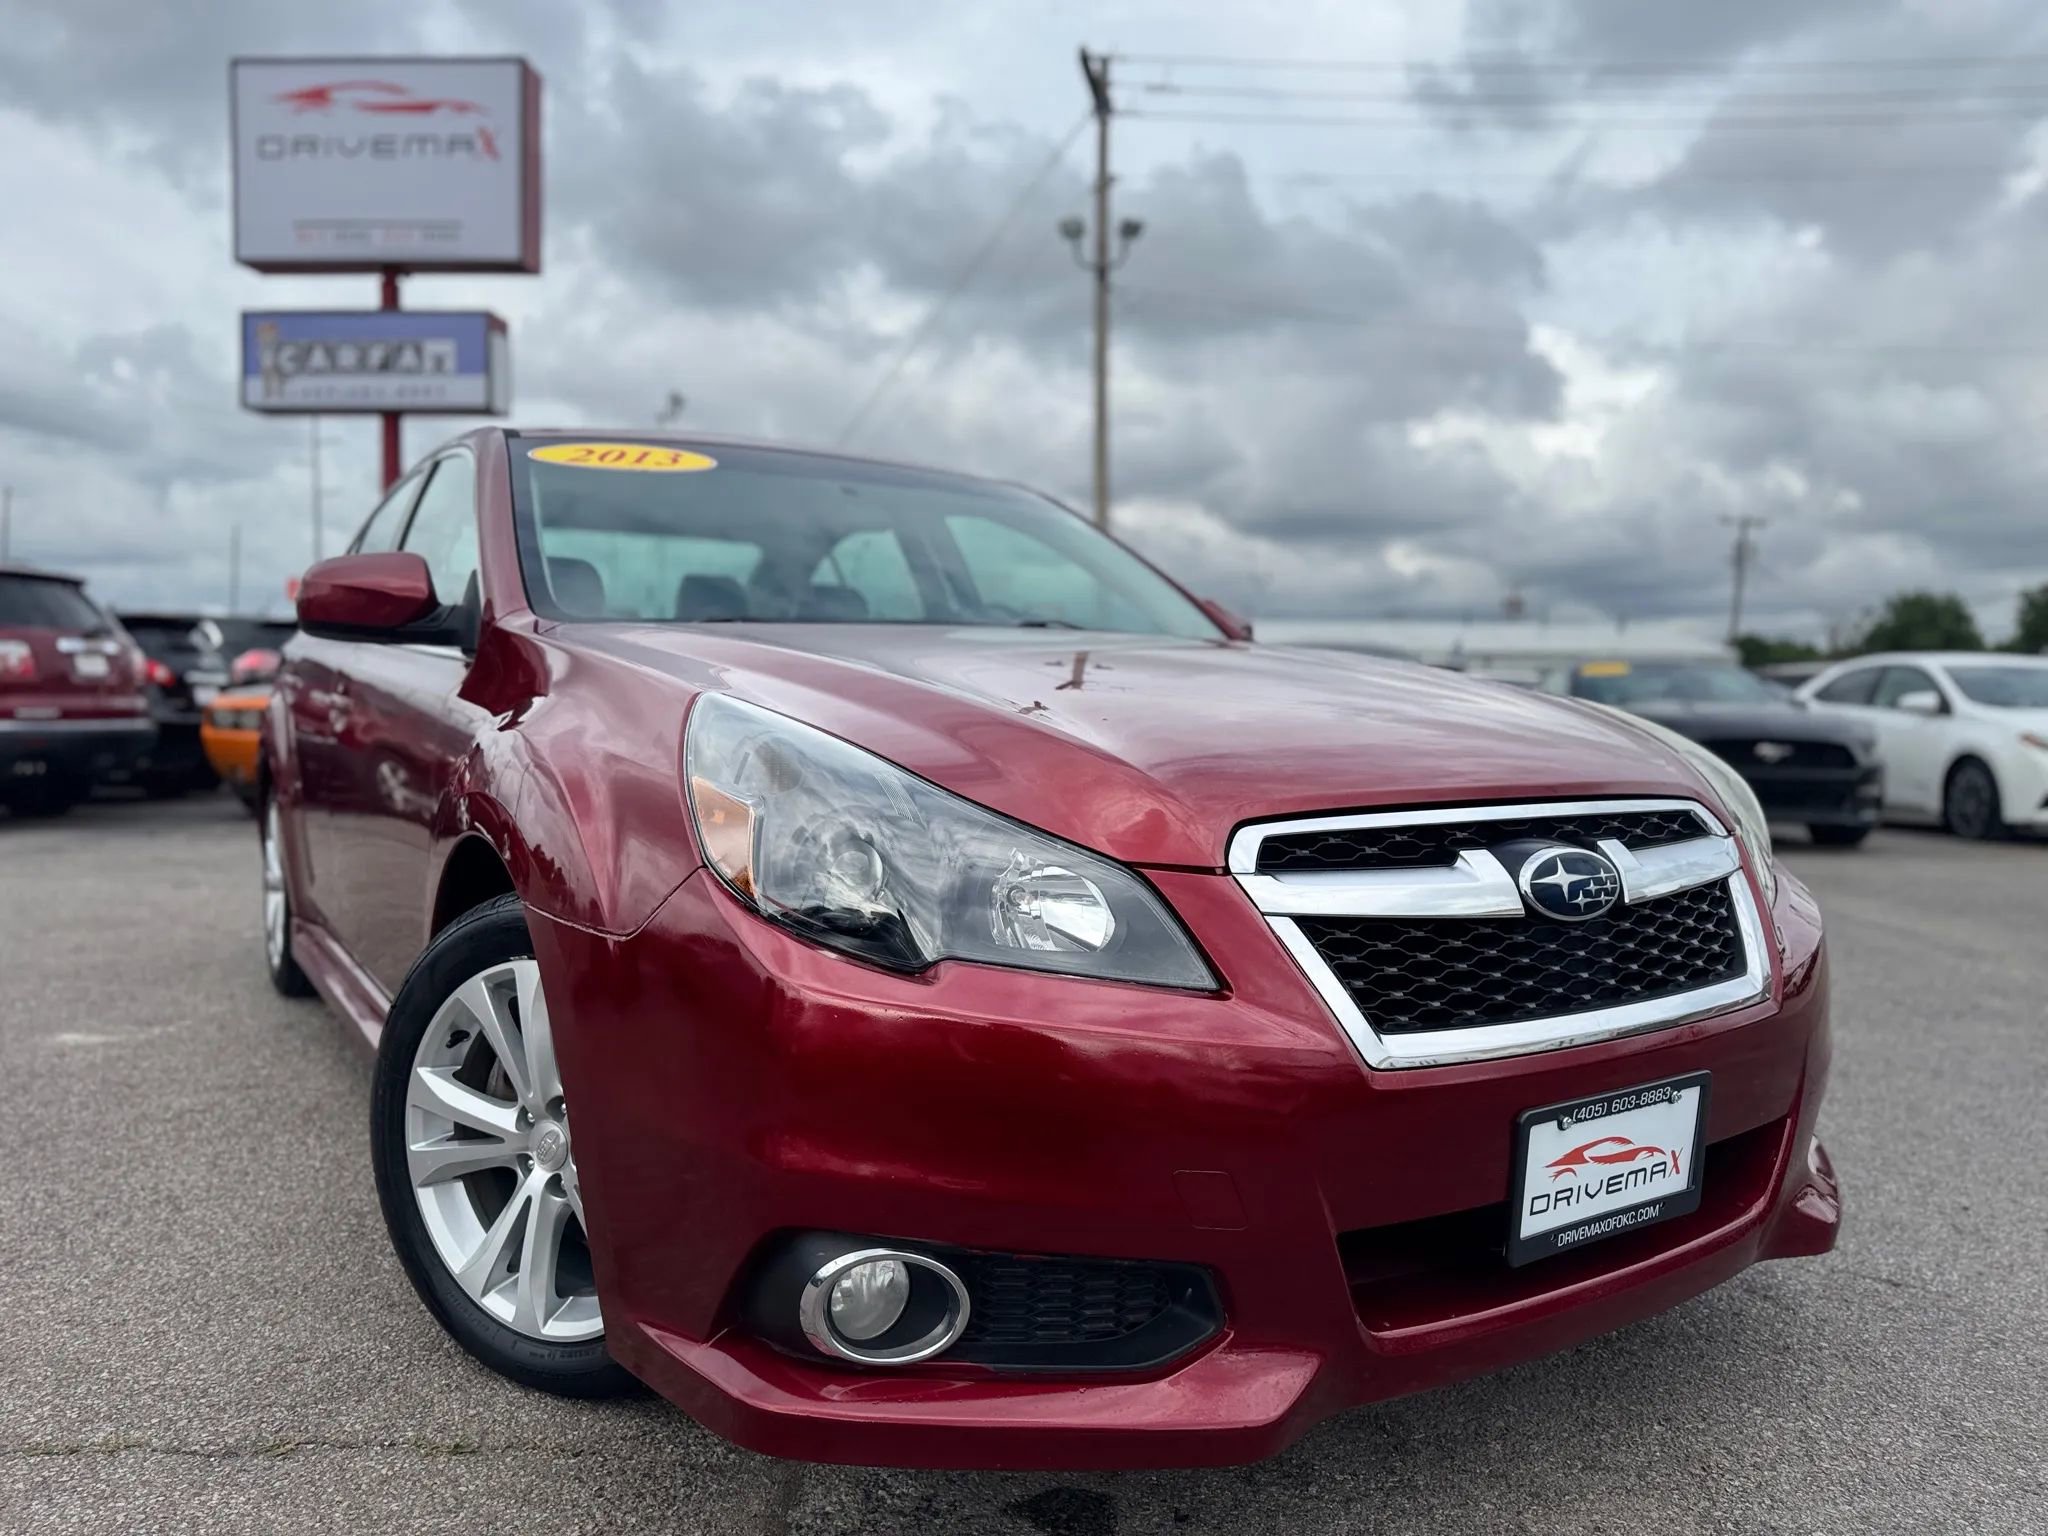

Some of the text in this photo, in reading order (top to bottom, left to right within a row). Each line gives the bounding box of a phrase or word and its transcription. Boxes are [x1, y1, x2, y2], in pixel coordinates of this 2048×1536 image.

[256, 125, 502, 162] DRIVEMAX
[566, 447, 683, 466] 2013
[1572, 1086, 1671, 1122] (405) 603-8883
[1529, 1147, 1684, 1217] DRIVEMAX
[1557, 1204, 1660, 1247] DRIVEMAXOFOKC.COM
